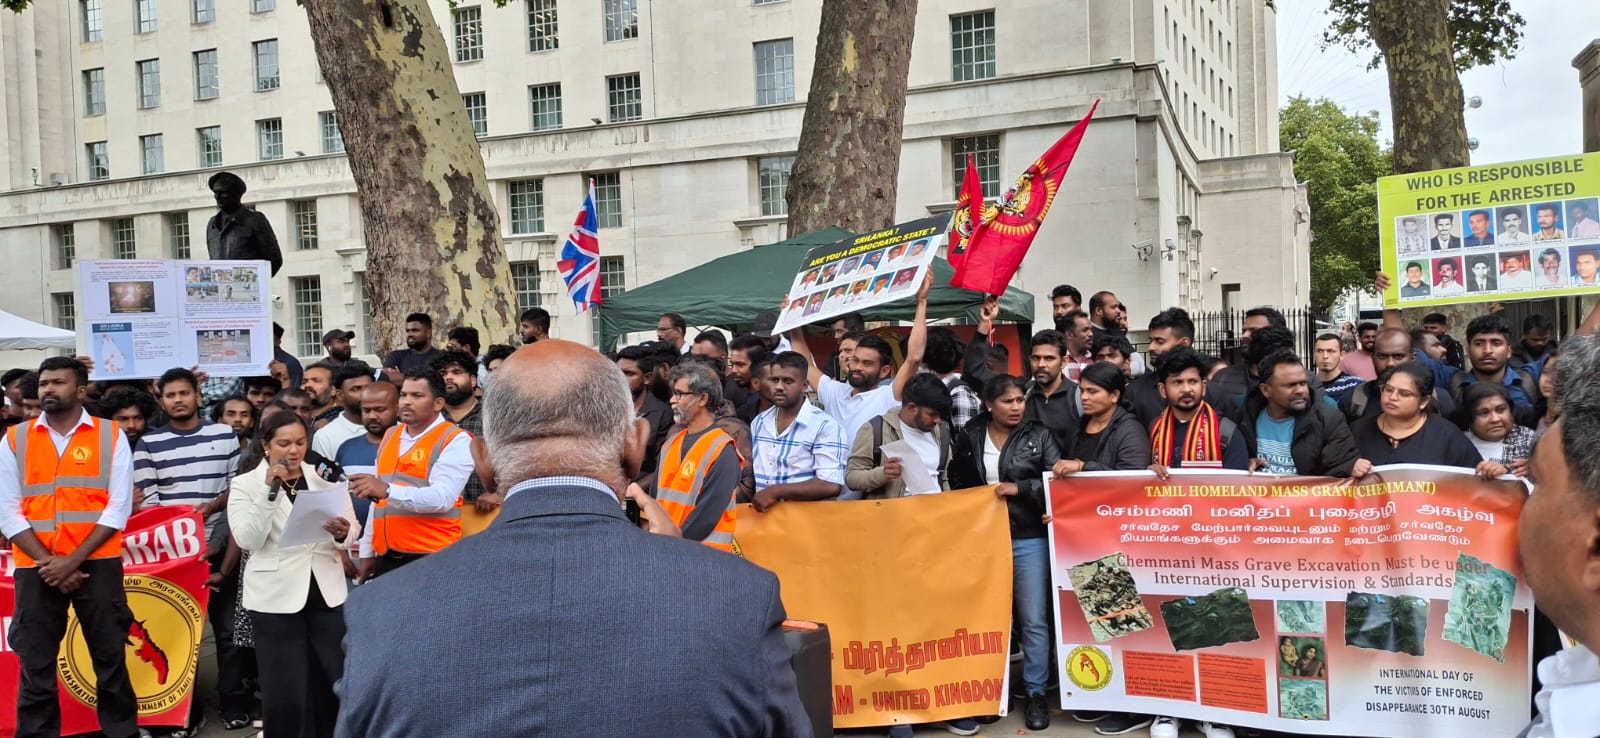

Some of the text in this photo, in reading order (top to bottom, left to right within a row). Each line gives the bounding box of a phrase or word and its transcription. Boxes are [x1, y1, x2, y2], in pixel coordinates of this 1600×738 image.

[1407, 158, 1584, 190] WHO IS RESPONSIBLE
[1417, 182, 1576, 211] FOR THE ARRESTED
[809, 258, 825, 267] ARE
[825, 253, 841, 264] YOU
[841, 249, 848, 257] A
[848, 235, 902, 256] DEMOCRATIC
[902, 229, 928, 241] STATE
[1266, 455, 1294, 465] PAUL
[1144, 485, 1186, 497] TAMIL
[1189, 485, 1268, 497] HOMELAND
[1271, 485, 1308, 497] MASS
[1096, 501, 1495, 525] செம்மணி மனிதப் புதைகுழி அகழ்வு
[1253, 534, 1335, 545] அமைவாக
[1116, 554, 1489, 575] Chemmani Mass Grave Excavation Must be under
[1154, 571, 1256, 588] International
[1261, 575, 1356, 592] Supervision
[1363, 576, 1377, 589] &
[843, 627, 1003, 678] பிரித்தானியா
[58, 655, 97, 705] TRANSNATIO
[136, 699, 167, 712] RNMENT
[168, 693, 177, 703] OF
[177, 677, 193, 697] TAMIL
[1379, 668, 1474, 682] INTERNATIONAL DAY OF
[872, 687, 930, 712] UNITED
[1374, 685, 1484, 701] THE VICTIMS OF ENFORCED
[1366, 702, 1490, 720] DISAPPEARANCE 30TH AUGUST
